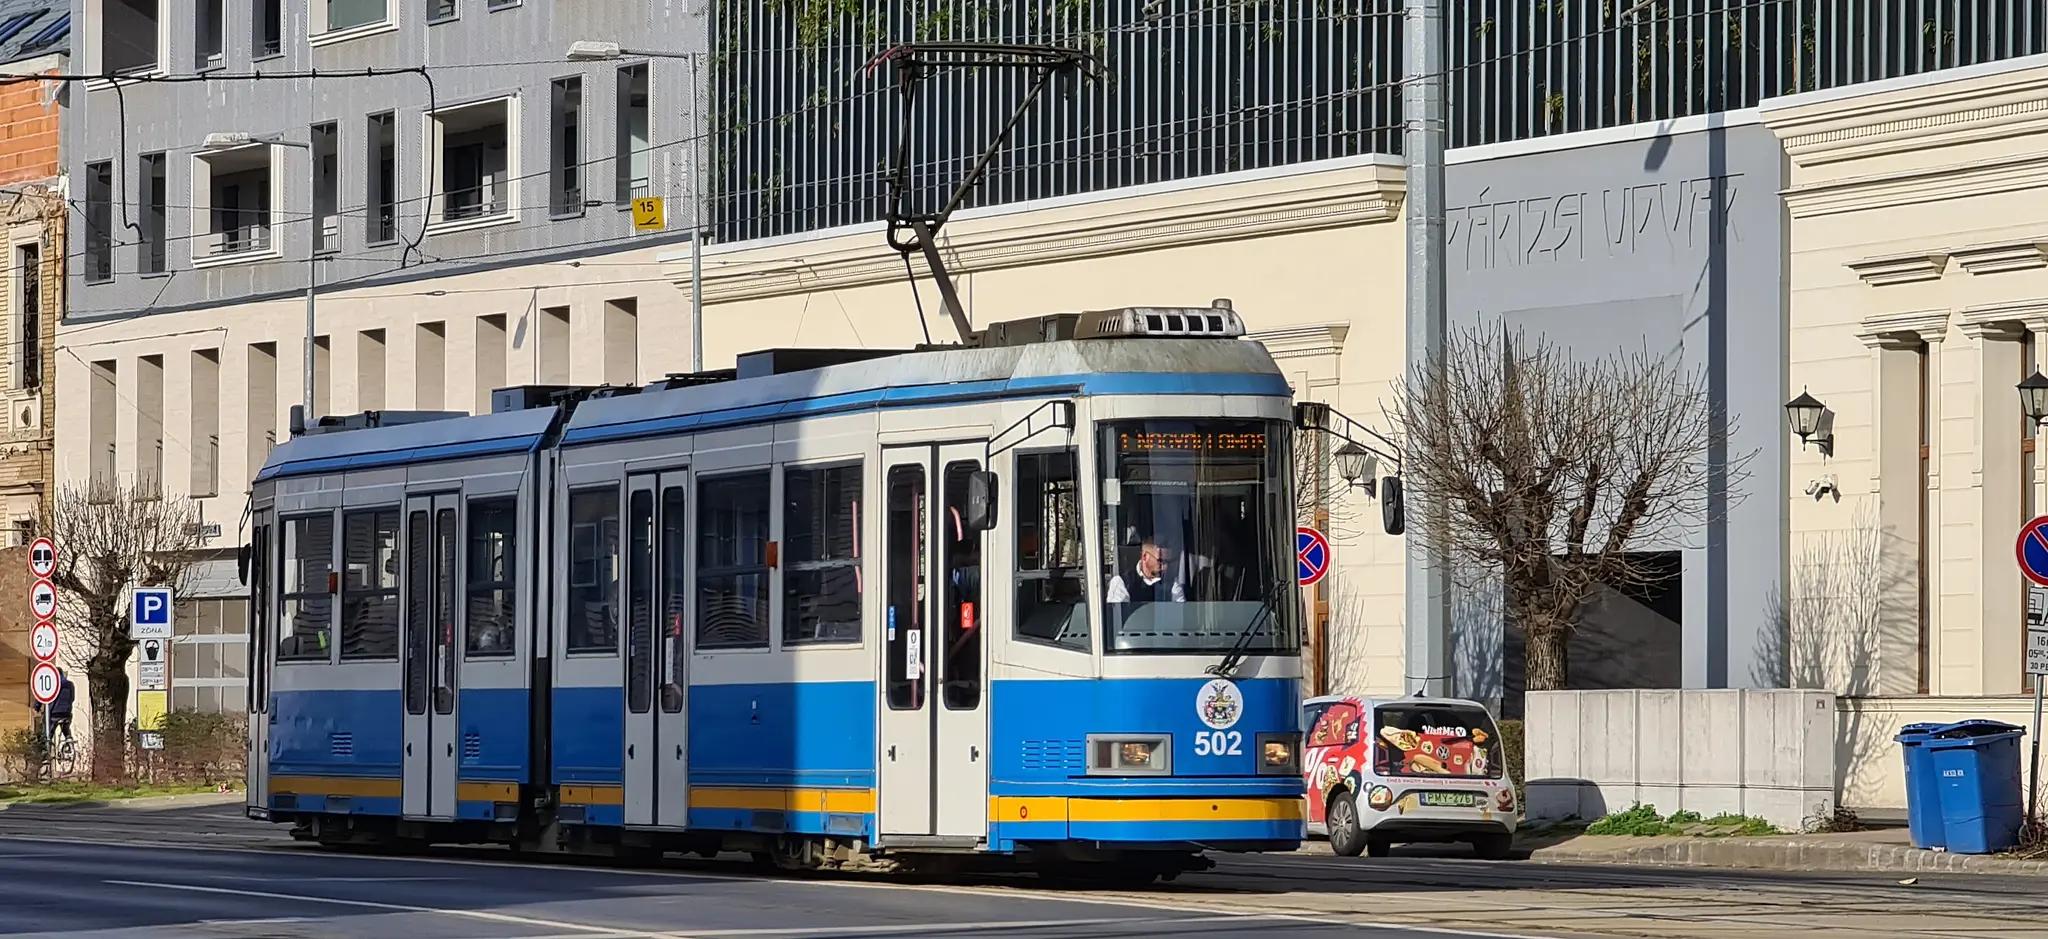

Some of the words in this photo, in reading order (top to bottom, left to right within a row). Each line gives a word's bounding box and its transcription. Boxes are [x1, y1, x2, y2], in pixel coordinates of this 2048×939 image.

[640, 201, 654, 213] 15
[1120, 433, 1128, 448] 1
[144, 596, 162, 620] P
[40, 675, 51, 691] 10
[1194, 731, 1242, 755] 502
